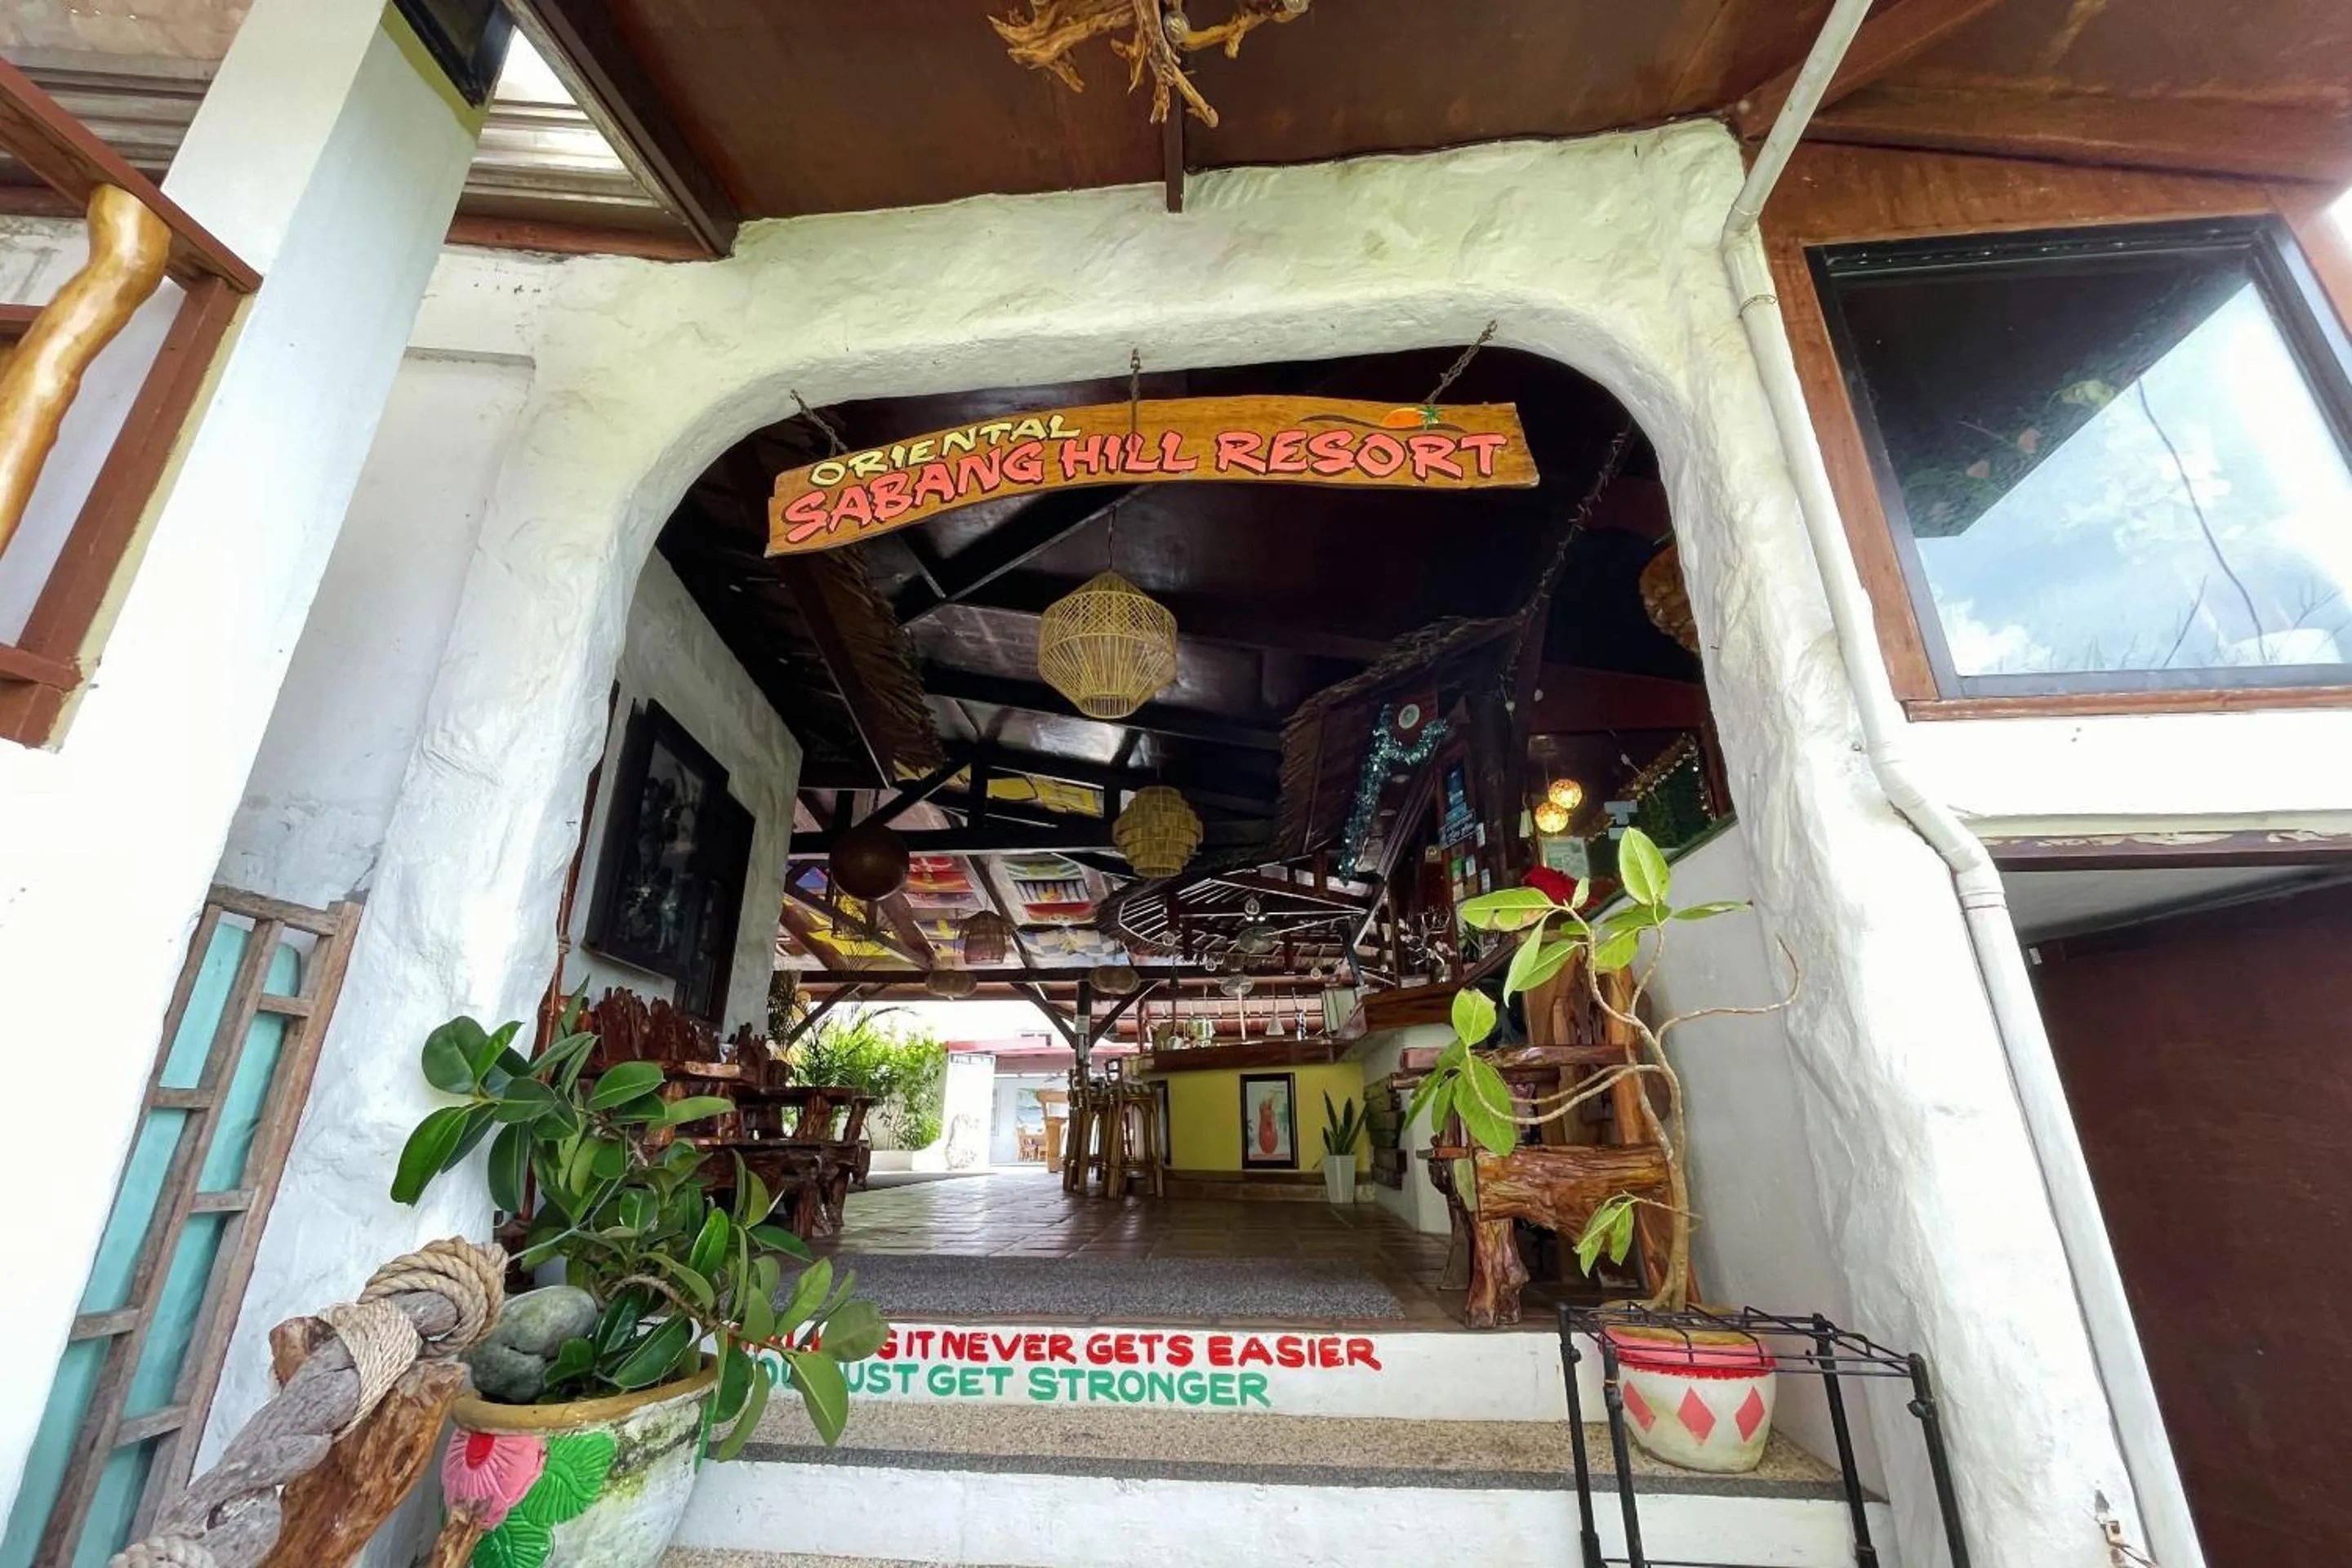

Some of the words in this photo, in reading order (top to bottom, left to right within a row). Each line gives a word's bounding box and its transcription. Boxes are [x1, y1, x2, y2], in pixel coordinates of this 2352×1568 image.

[808, 414, 1081, 487] ORIENTAL
[783, 439, 1045, 545] SABANG
[1061, 430, 1199, 481] HILL
[1214, 429, 1508, 480] RESORT
[906, 1330, 935, 1361] IT
[942, 1330, 1077, 1365] NEVER
[1085, 1333, 1195, 1368] GETS
[1207, 1335, 1383, 1372] EASIER
[841, 1361, 920, 1395] UST
[927, 1364, 1014, 1396] GET
[1027, 1366, 1272, 1408] STRONGER
